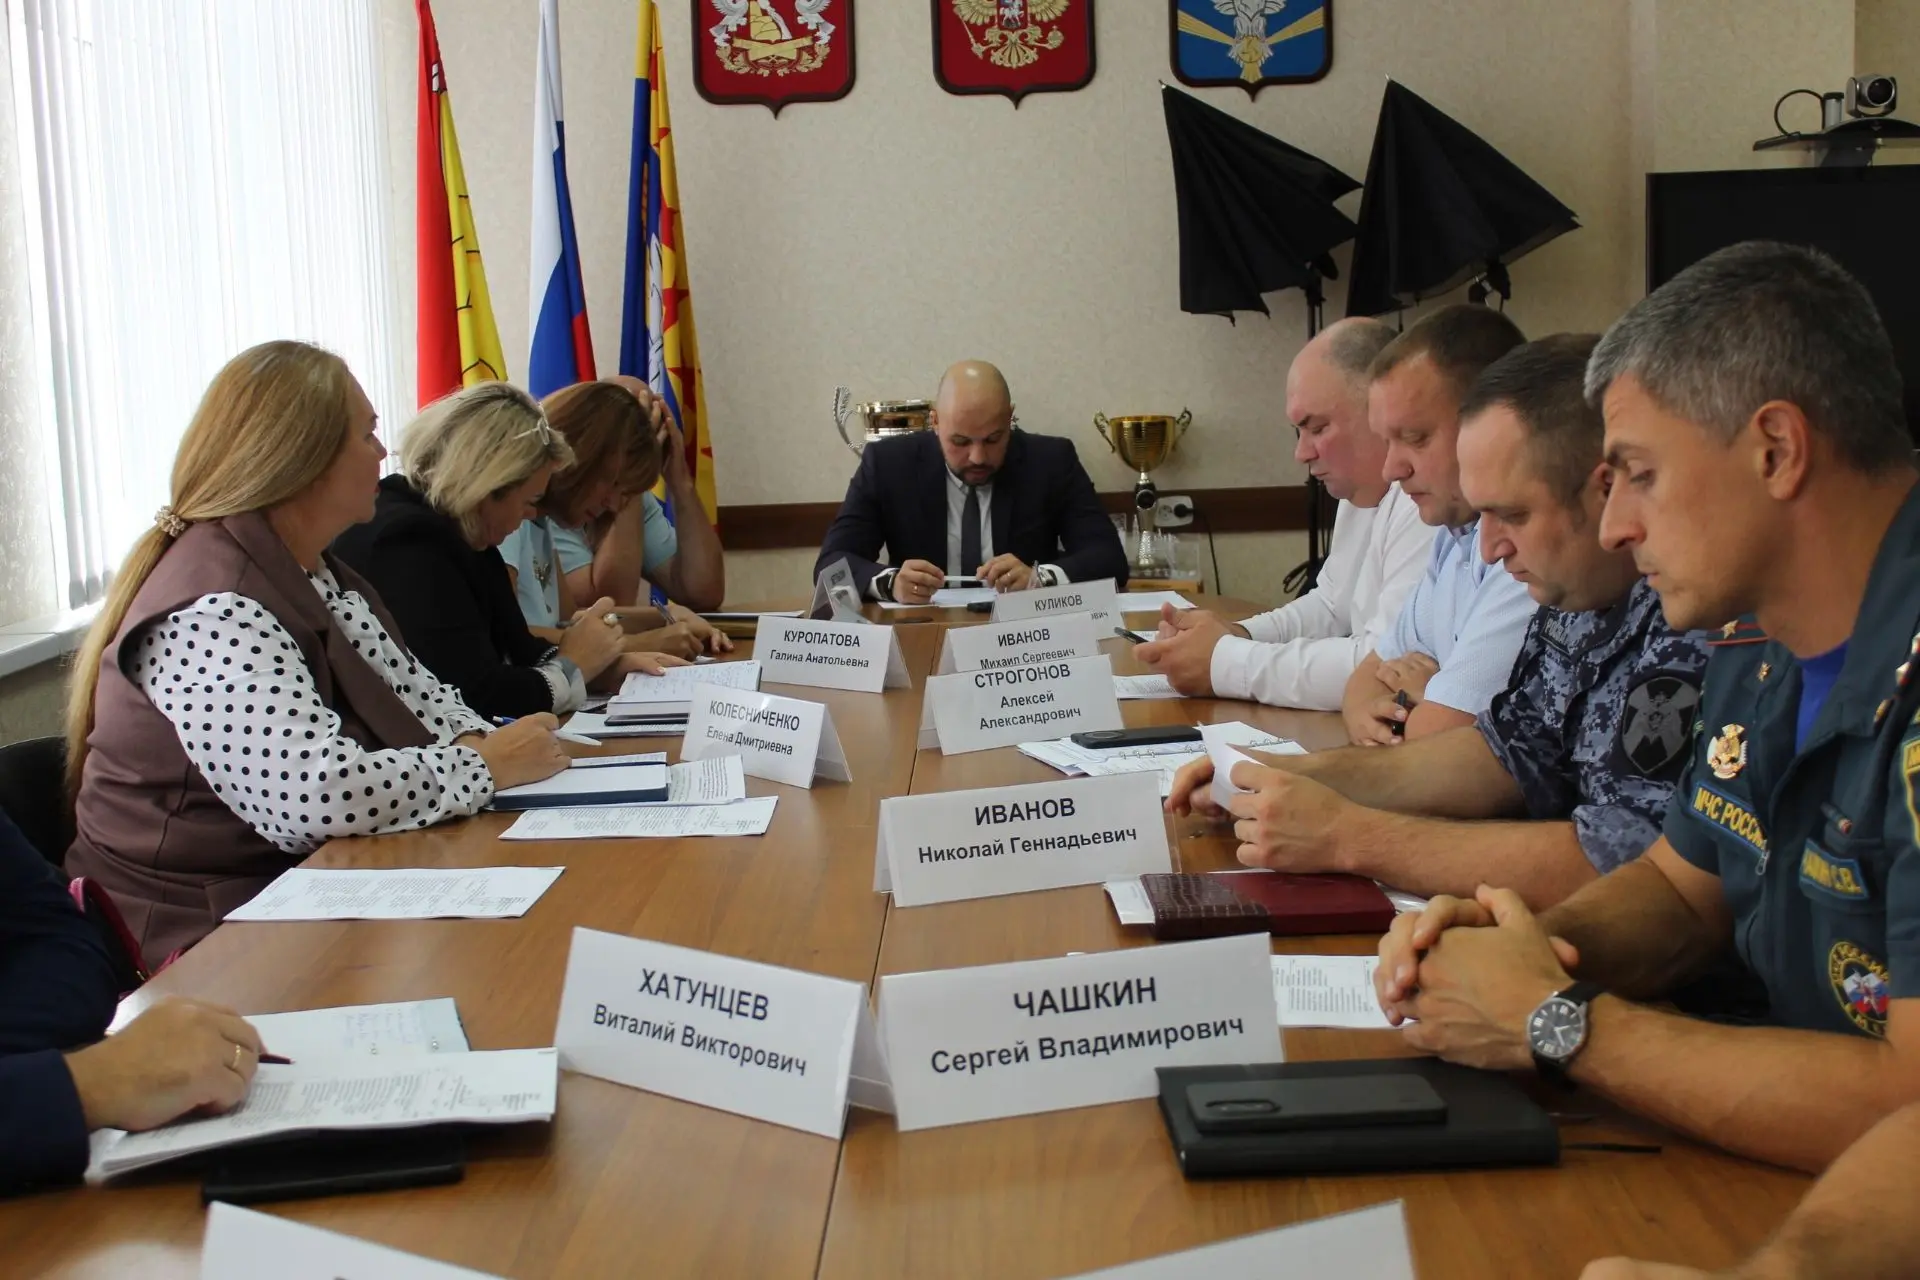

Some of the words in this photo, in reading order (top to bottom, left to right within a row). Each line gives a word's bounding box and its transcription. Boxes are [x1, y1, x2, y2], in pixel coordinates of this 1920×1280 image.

[1034, 594, 1083, 612] КУЛИКОВ
[783, 630, 861, 648] КУРОПАТОВА
[998, 628, 1051, 648] ИВАНОВ
[770, 649, 803, 662] Галина
[805, 652, 869, 668] Анатольевна
[980, 656, 1020, 670] Михаил
[1022, 648, 1076, 664] Сергеевич
[974, 663, 1071, 688] СТРОГОНОВ
[1000, 690, 1055, 708] Алексей
[709, 700, 800, 731] КОЛЕСНИЧЕНКО
[979, 707, 1082, 730] Александрович
[706, 725, 734, 743] Елена
[735, 731, 793, 756] Дмитриевна
[975, 797, 1076, 825] ИВАНОВ
[1693, 787, 1723, 820] МЧС
[918, 838, 1005, 864] Николай
[1010, 828, 1137, 854] Геннадьевич
[638, 967, 770, 1021] ХАТУНЦЕВ
[1013, 976, 1158, 1018] ЧАШКИН
[593, 1003, 676, 1043] Виталий
[680, 1024, 807, 1077] Викторович
[931, 1041, 1030, 1075] Сергей
[1038, 1017, 1245, 1060] Владимирович
